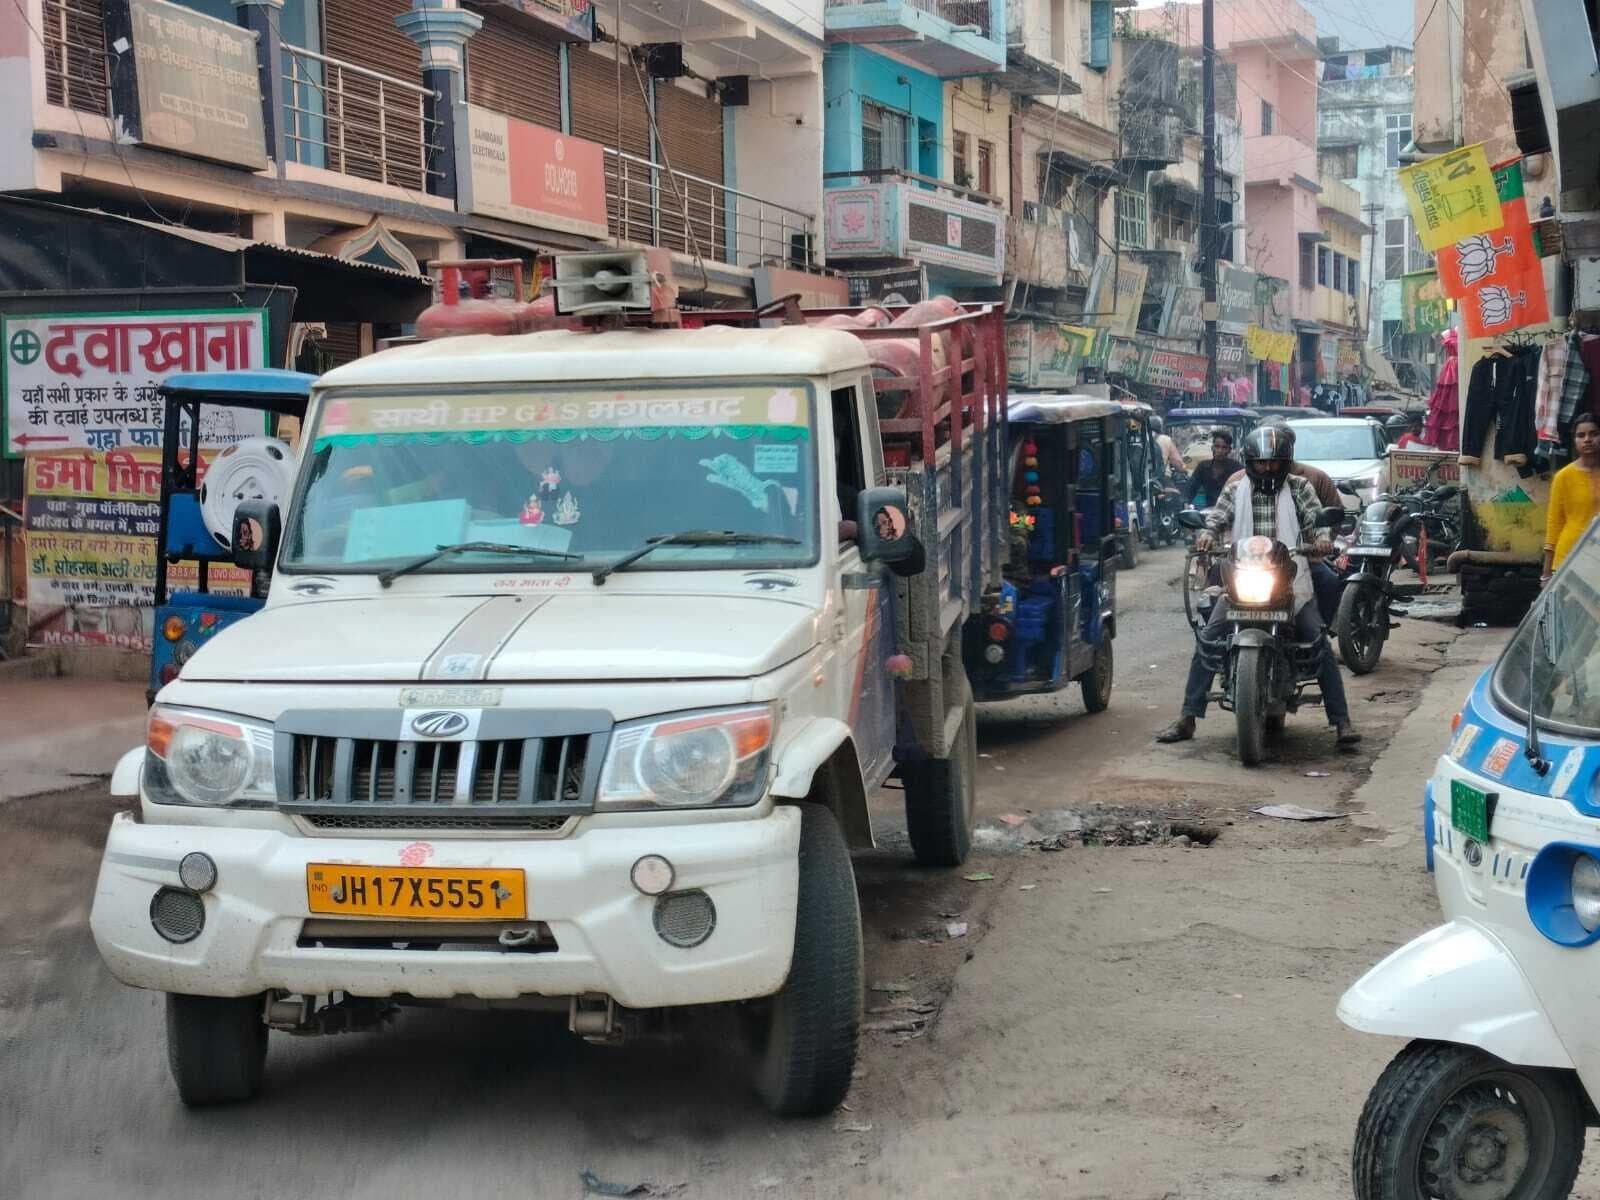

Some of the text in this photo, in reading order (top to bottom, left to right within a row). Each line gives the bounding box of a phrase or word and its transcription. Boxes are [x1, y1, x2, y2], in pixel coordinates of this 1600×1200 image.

[45, 320, 254, 377] दवाखाना
[28, 404, 48, 425] की
[93, 407, 148, 427] उपलब्ध
[332, 875, 505, 910] JH17X5551
